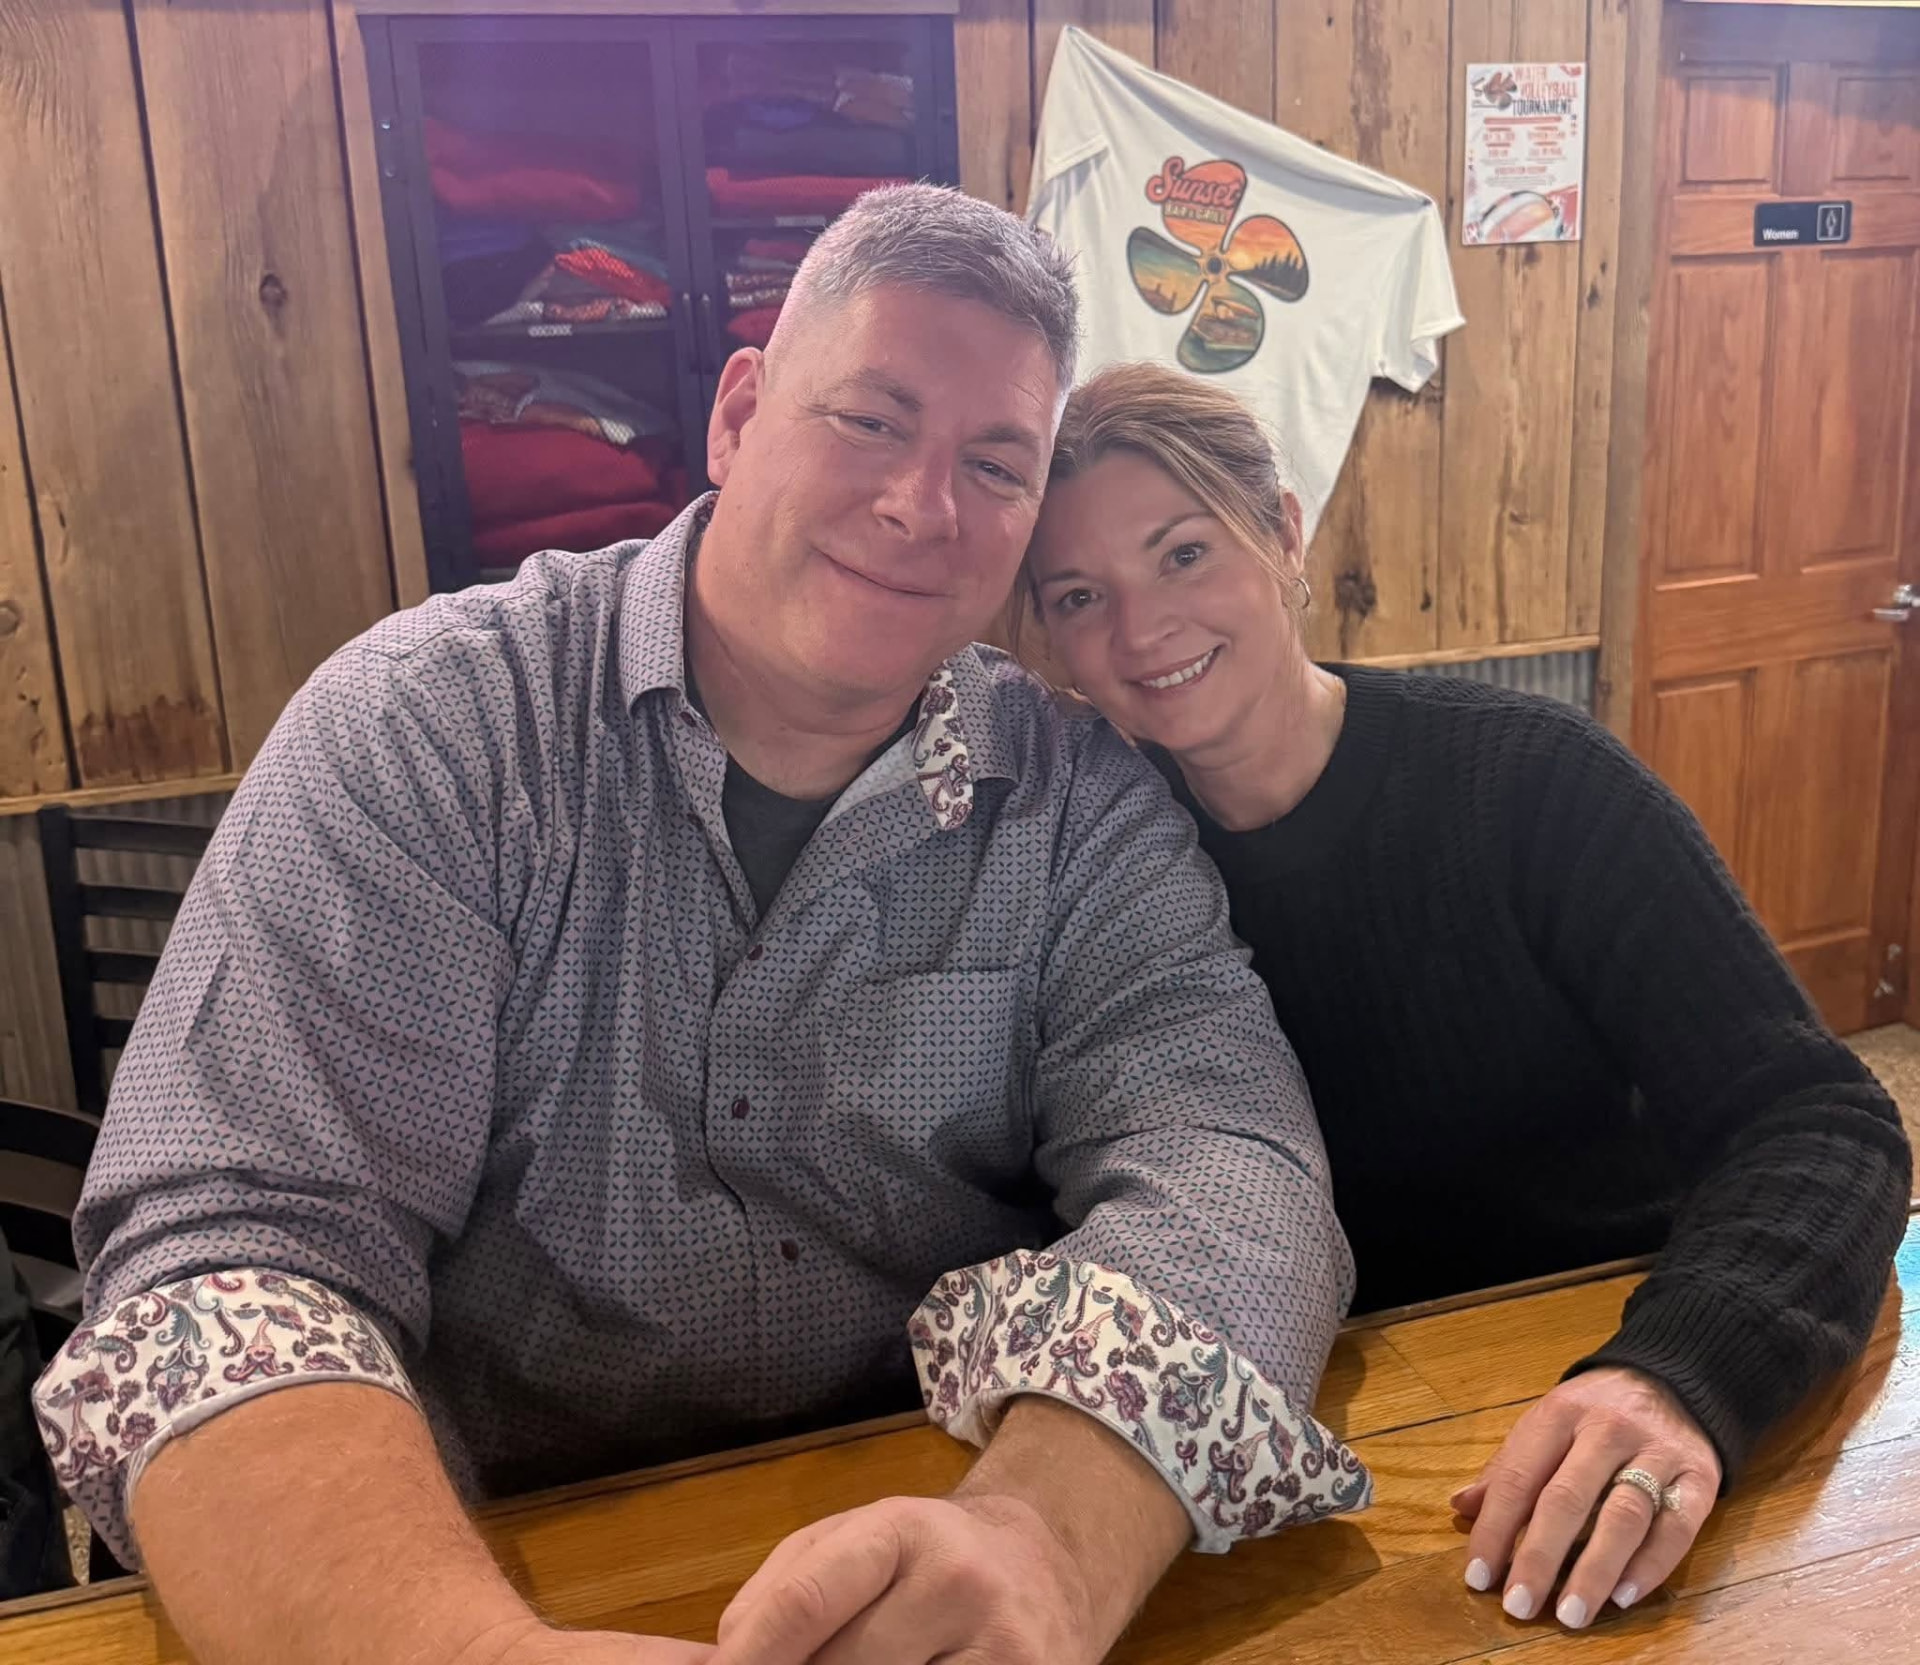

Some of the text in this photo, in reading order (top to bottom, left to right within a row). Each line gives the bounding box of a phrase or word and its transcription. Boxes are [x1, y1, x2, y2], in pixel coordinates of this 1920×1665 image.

[1514, 66, 1547, 81] WATER
[1520, 82, 1577, 99] VOLLEYBALL
[1512, 99, 1572, 116] TOURNAMENT
[1145, 156, 1241, 209] Sunset
[1762, 228, 1799, 240] Women
